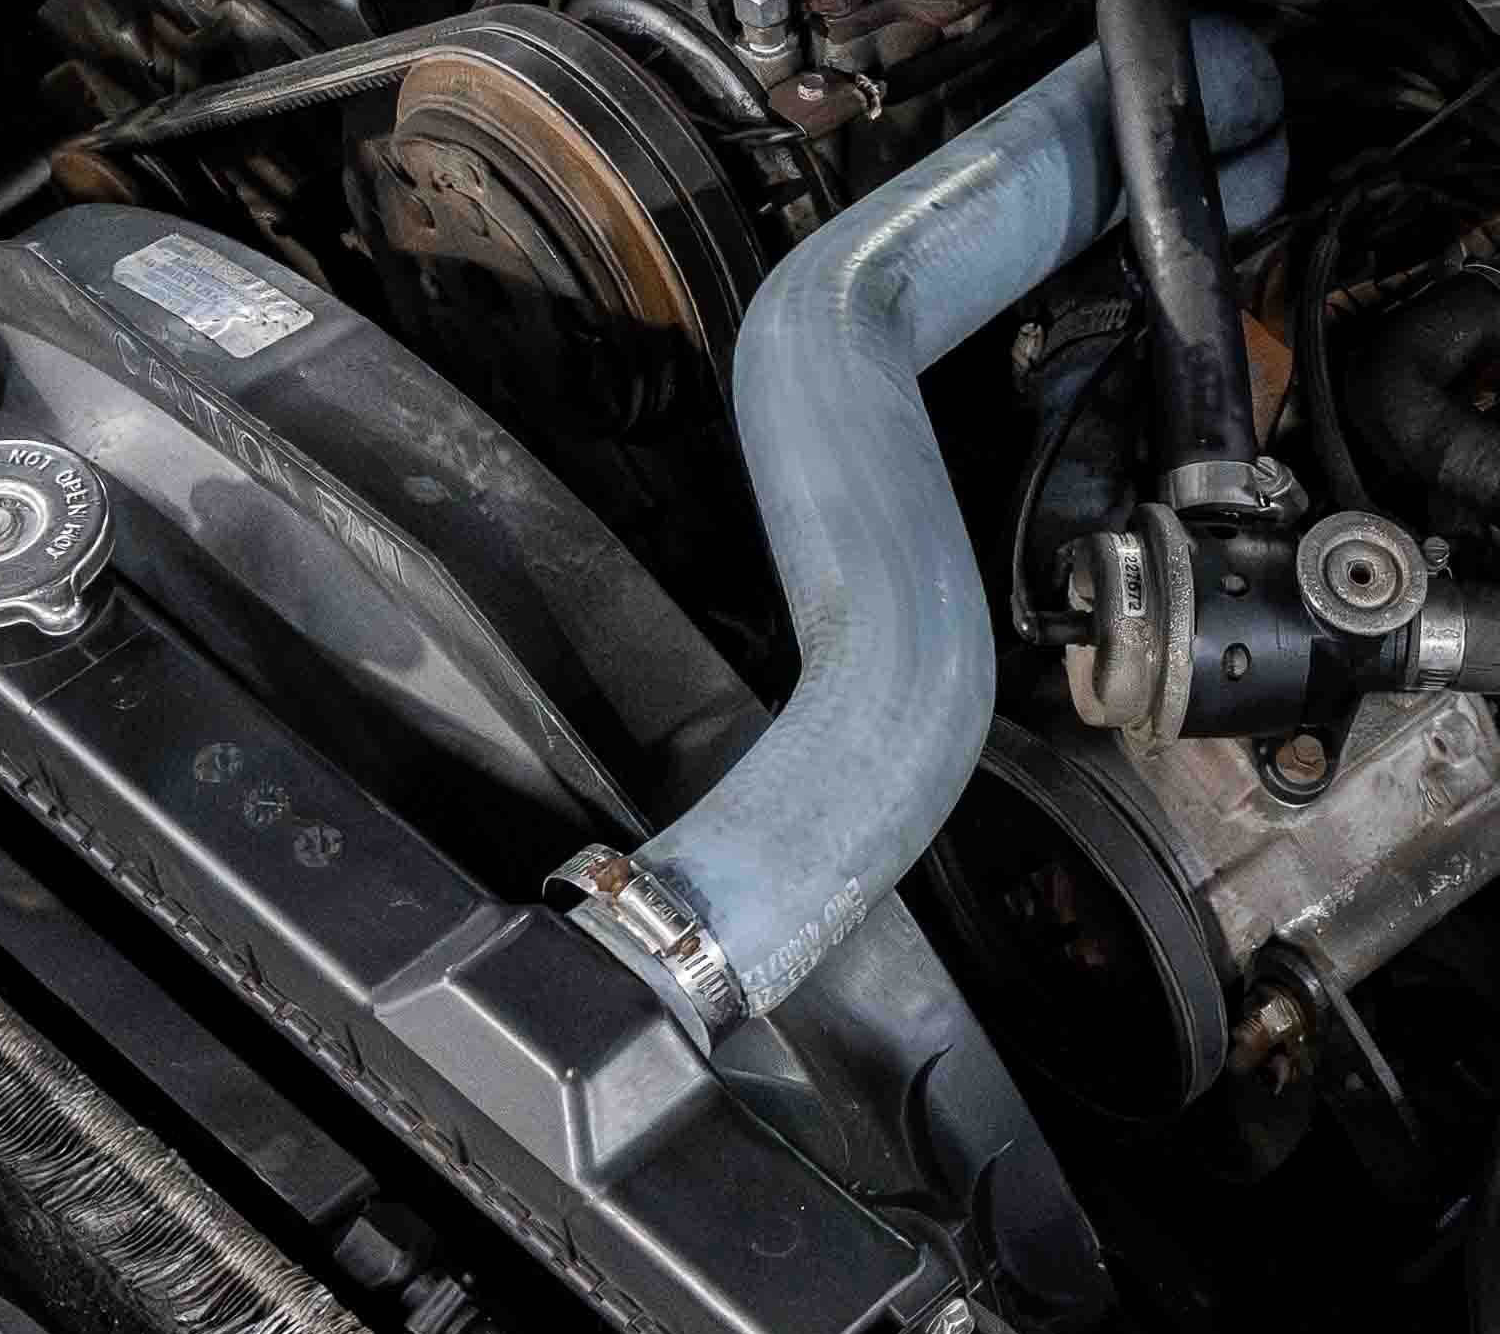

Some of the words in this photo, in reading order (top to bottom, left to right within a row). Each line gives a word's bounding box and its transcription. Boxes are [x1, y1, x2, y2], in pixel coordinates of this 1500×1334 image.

[8, 448, 54, 469] NOT
[55, 469, 88, 521] OPEN
[44, 522, 84, 559] HOT
[316, 485, 409, 587] FAN
